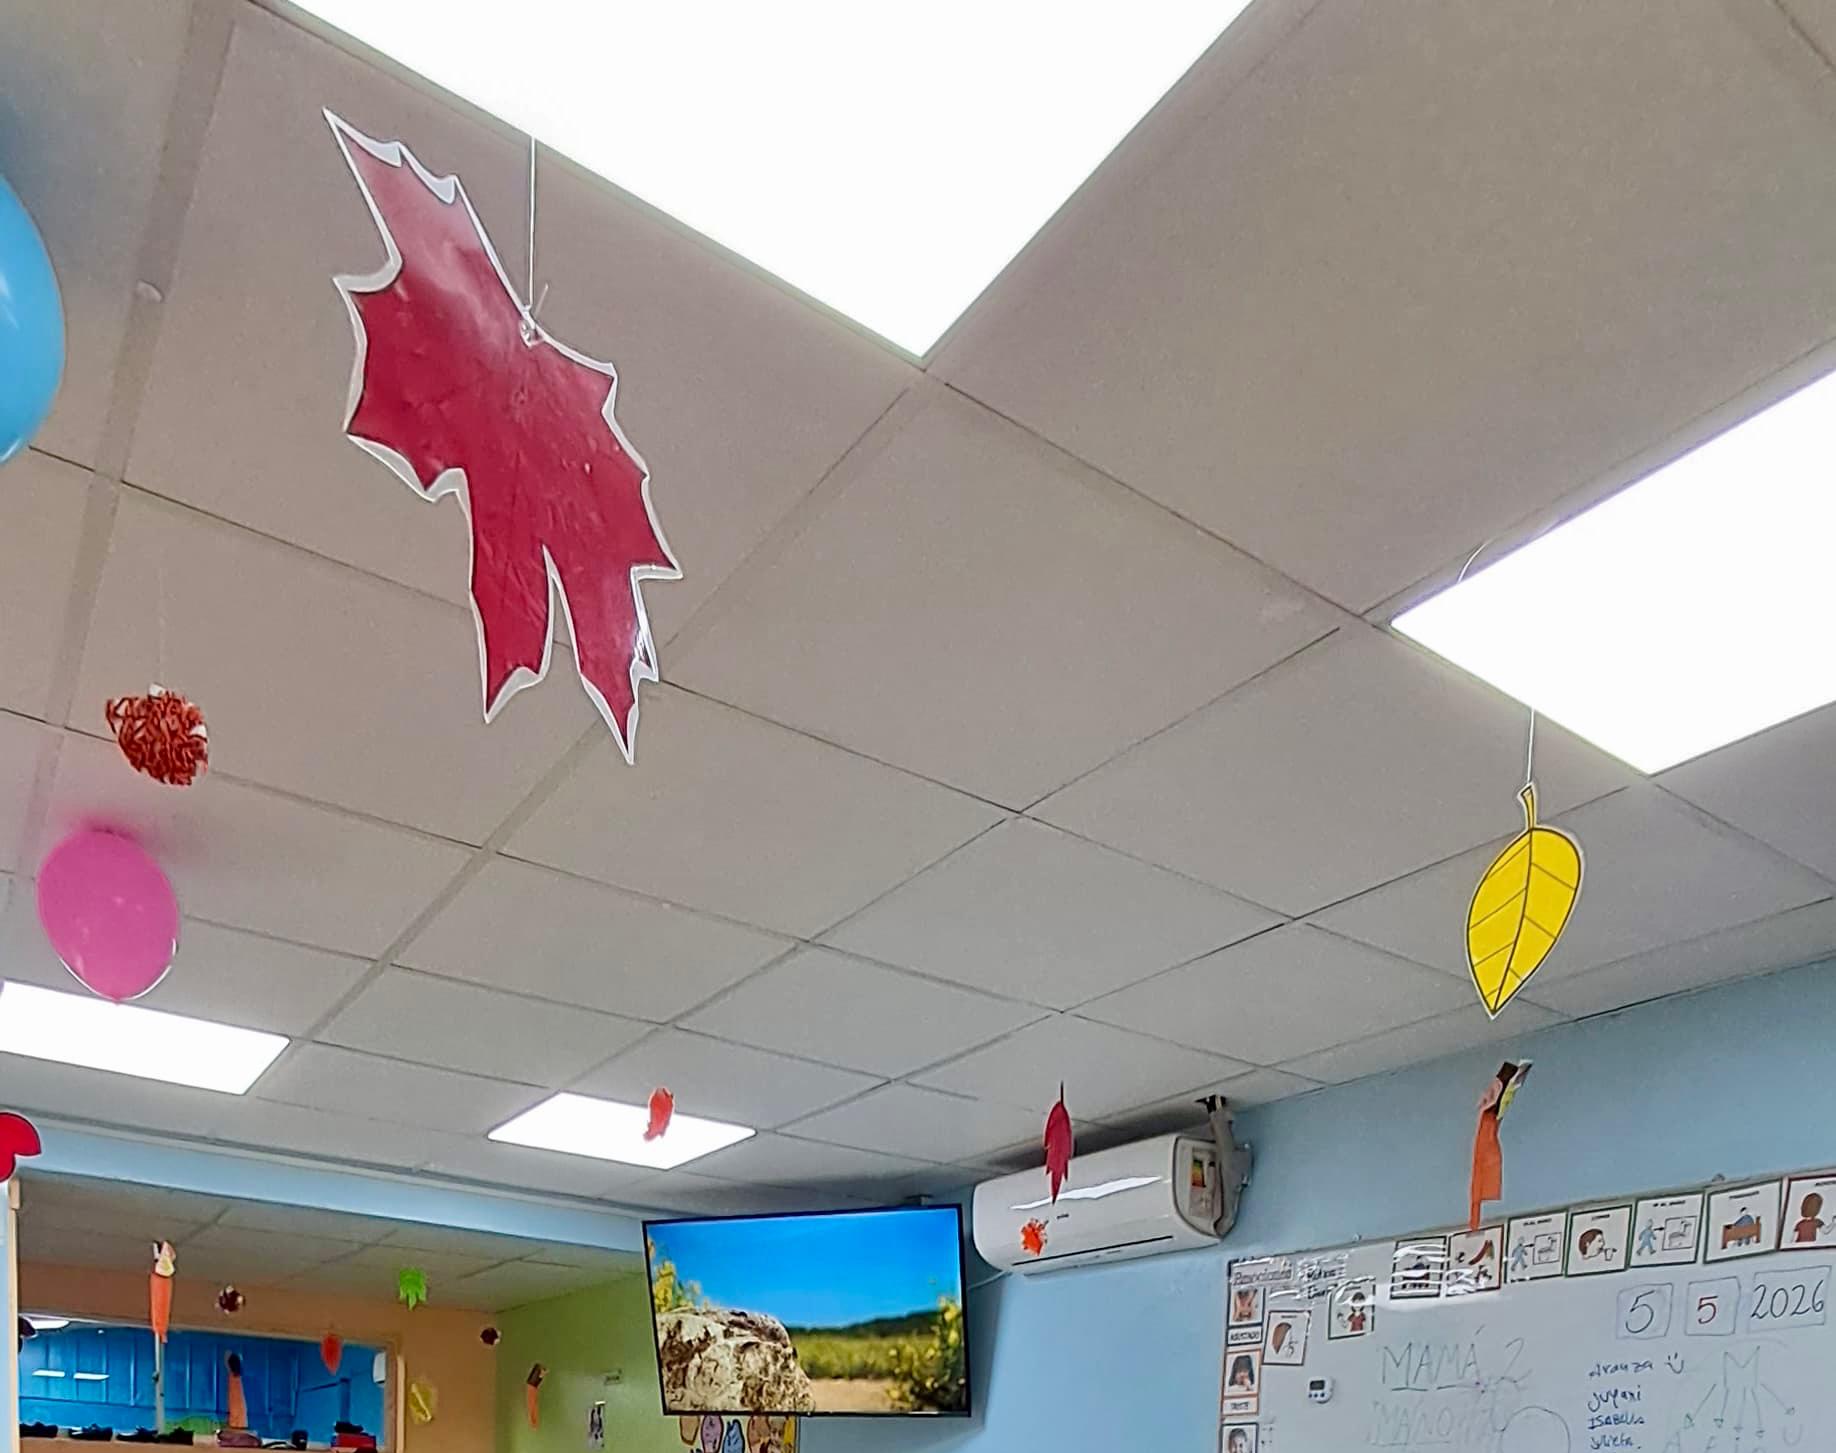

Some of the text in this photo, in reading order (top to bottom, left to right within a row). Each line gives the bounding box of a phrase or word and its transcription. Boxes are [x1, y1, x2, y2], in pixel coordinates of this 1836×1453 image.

[1625, 1280, 1825, 1334] 5 5 2026
